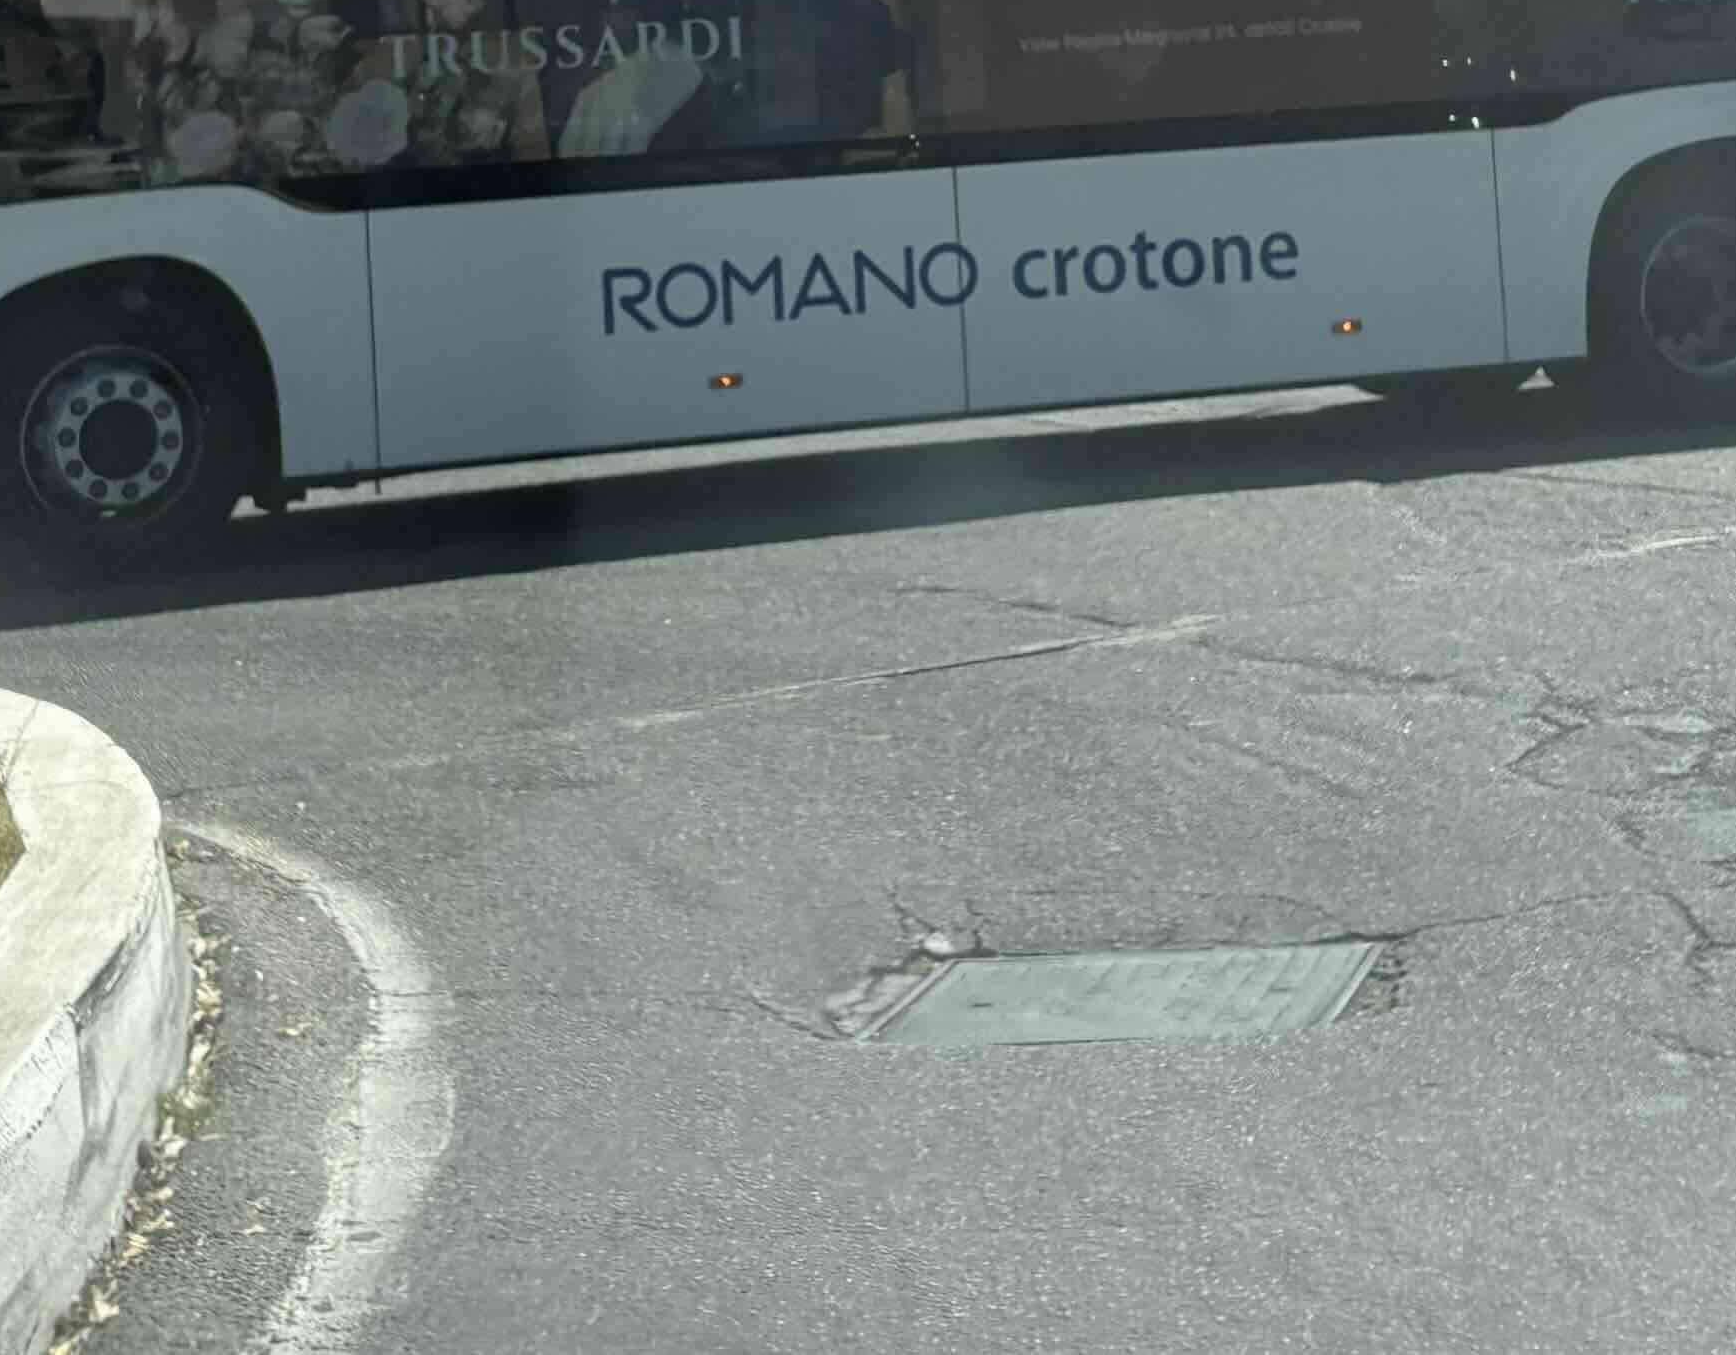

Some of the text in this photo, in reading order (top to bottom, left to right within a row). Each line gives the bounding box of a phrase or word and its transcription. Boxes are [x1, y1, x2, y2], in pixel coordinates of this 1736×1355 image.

[381, 15, 745, 80] TRUSSARDI
[601, 231, 1300, 336] ROMANO crotone
